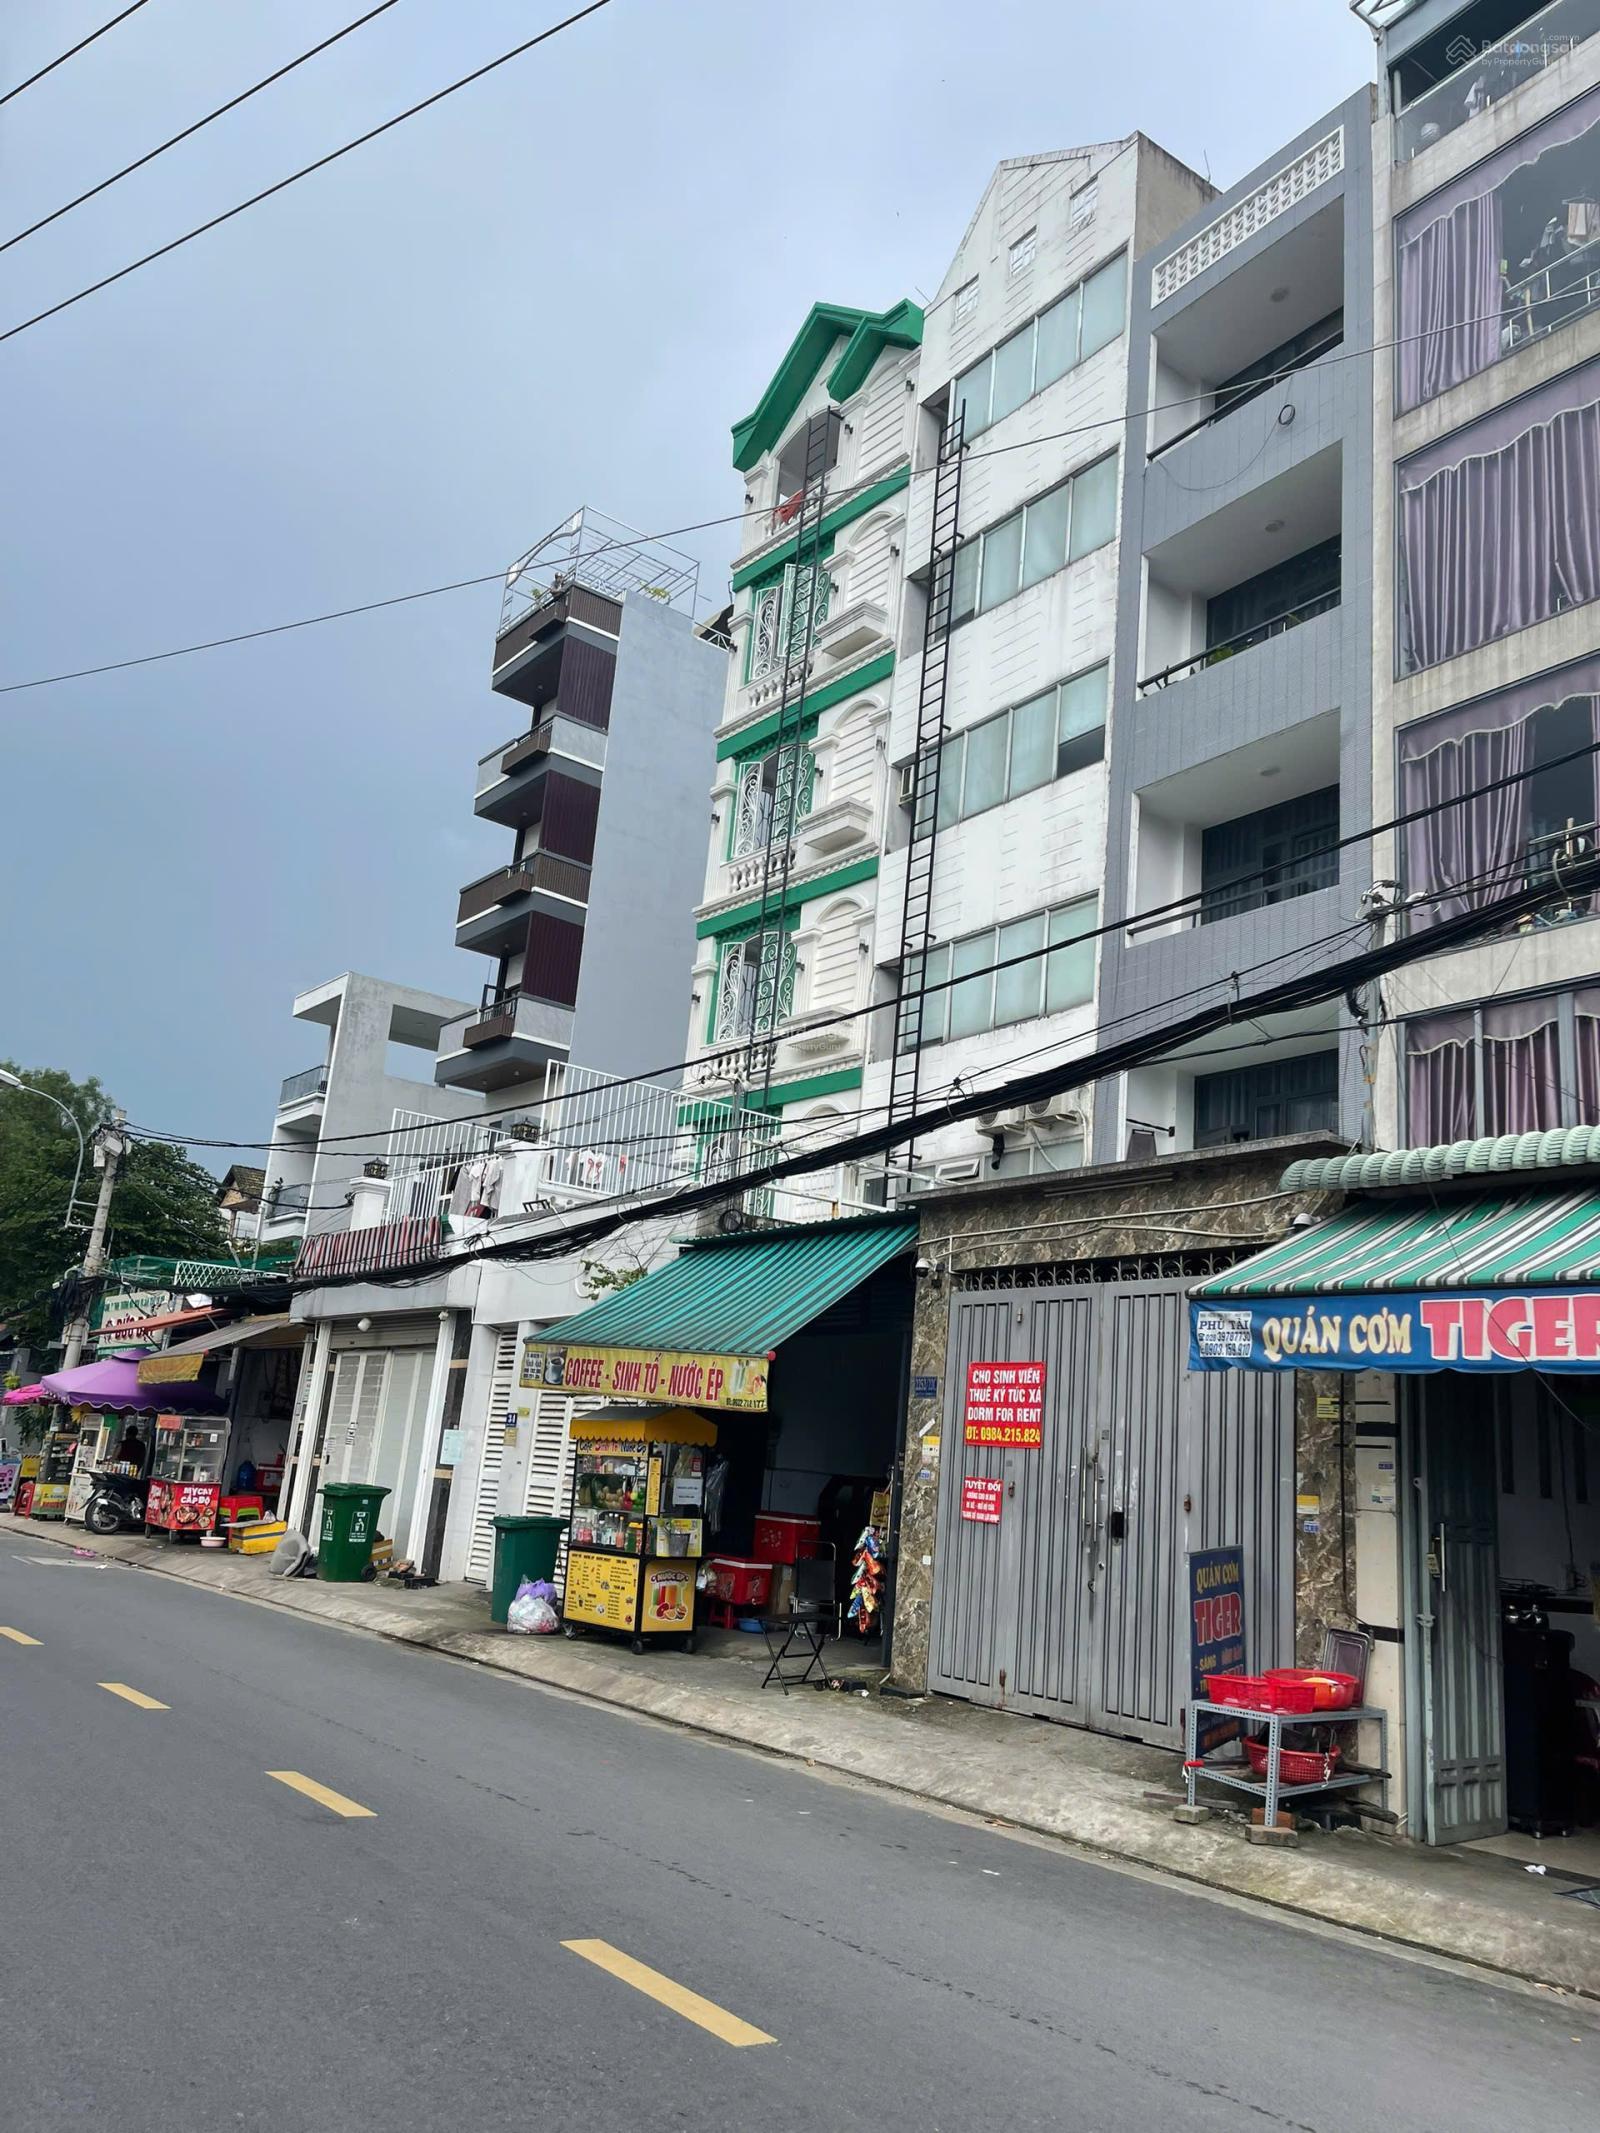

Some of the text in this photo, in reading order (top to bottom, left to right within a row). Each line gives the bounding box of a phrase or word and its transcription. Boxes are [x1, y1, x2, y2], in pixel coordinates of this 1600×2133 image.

[1262, 1293, 1600, 1362] QUÁN CƠM TIGER
[565, 1357, 604, 1388] COFFEE
[612, 1360, 642, 1392] SINH
[643, 1353, 662, 1395] TỐ
[668, 1360, 704, 1400] NƯỚC
[706, 1361, 724, 1401] ÉP
[973, 1368, 1041, 1384] CHO SINH VIÊN
[969, 1386, 991, 1403] THUÊ
[993, 1386, 1006, 1403] KÝ
[1008, 1386, 1026, 1403] TÚC
[967, 1407, 1042, 1423] DORM FOR RENT
[981, 1427, 1040, 1443] 0984.215.824
[965, 1480, 986, 1492] TUYỆT
[1196, 1561, 1221, 1594] QUÁN
[1194, 1592, 1242, 1646] TIGER
